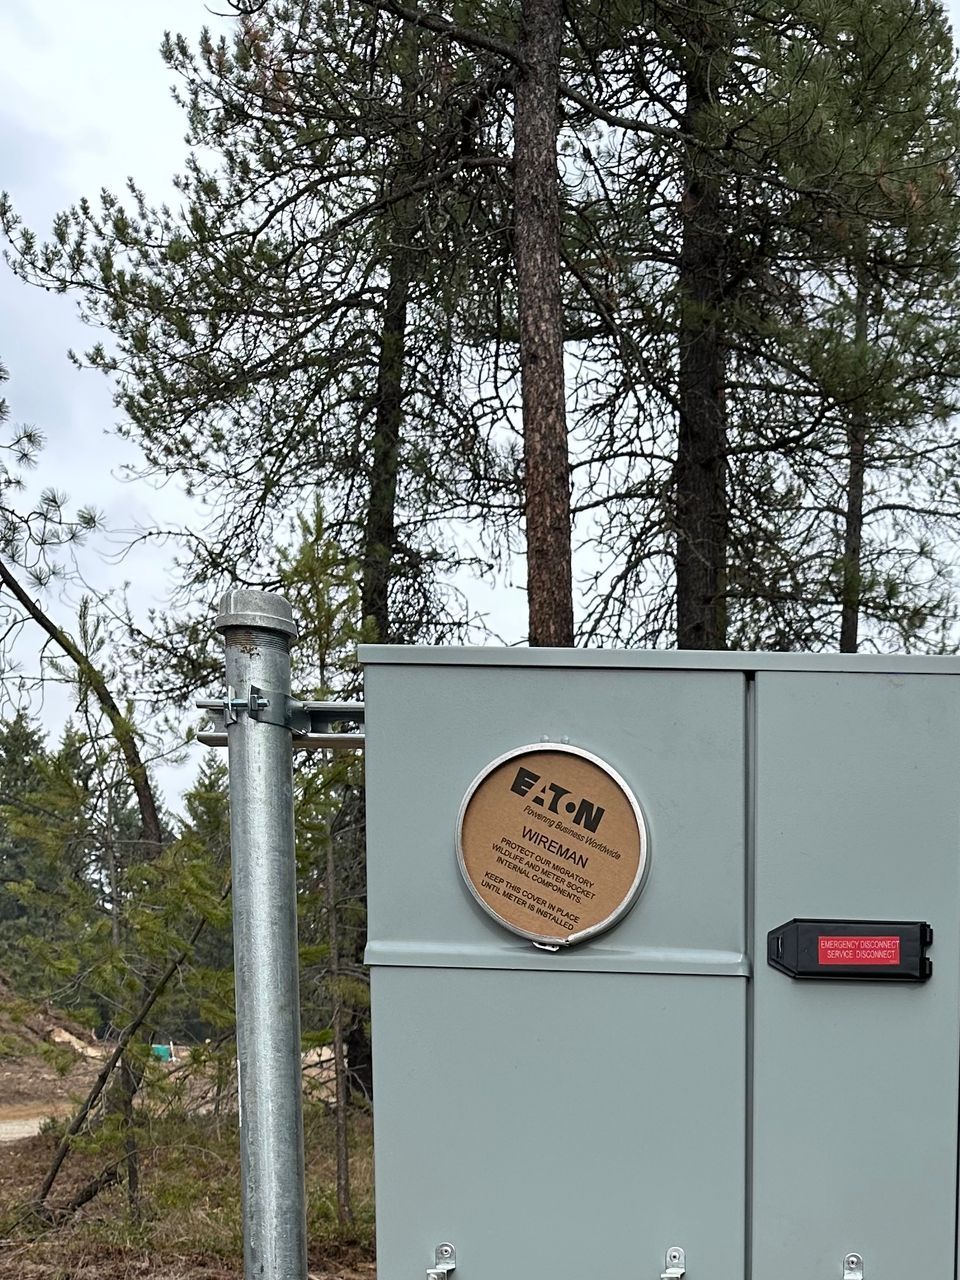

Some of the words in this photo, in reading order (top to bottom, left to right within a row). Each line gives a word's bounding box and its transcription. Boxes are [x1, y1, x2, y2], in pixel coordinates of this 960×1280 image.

[509, 766, 605, 834] EATON
[521, 825, 589, 869] WIREMAN
[522, 804, 556, 828] Powering
[554, 820, 585, 842] Business
[584, 835, 621, 860] Worldwide
[492, 842, 525, 864] WILDLIFE
[523, 860, 540, 872] AND
[540, 867, 566, 885] METER
[565, 881, 596, 900] SOCKET
[495, 855, 530, 879] INTERNAL
[531, 874, 582, 905] COMPONENTS.
[500, 836, 535, 858] PROTECT
[534, 854, 552, 868] OUR
[551, 863, 595, 888] MIGRATORY
[480, 879, 501, 895] UNTIL
[501, 889, 527, 908] METER
[527, 902, 536, 912] IS
[535, 906, 574, 931] INSTALLED
[484, 870, 505, 884] KEEP
[505, 880, 522, 894] THIS
[521, 889, 547, 907] COVER
[547, 902, 556, 911] IN
[555, 906, 580, 924] PLACE
[821, 940, 860, 949] EMERGENCY
[860, 940, 899, 949] DISCONNECT
[856, 950, 895, 958] DISCONNECT
